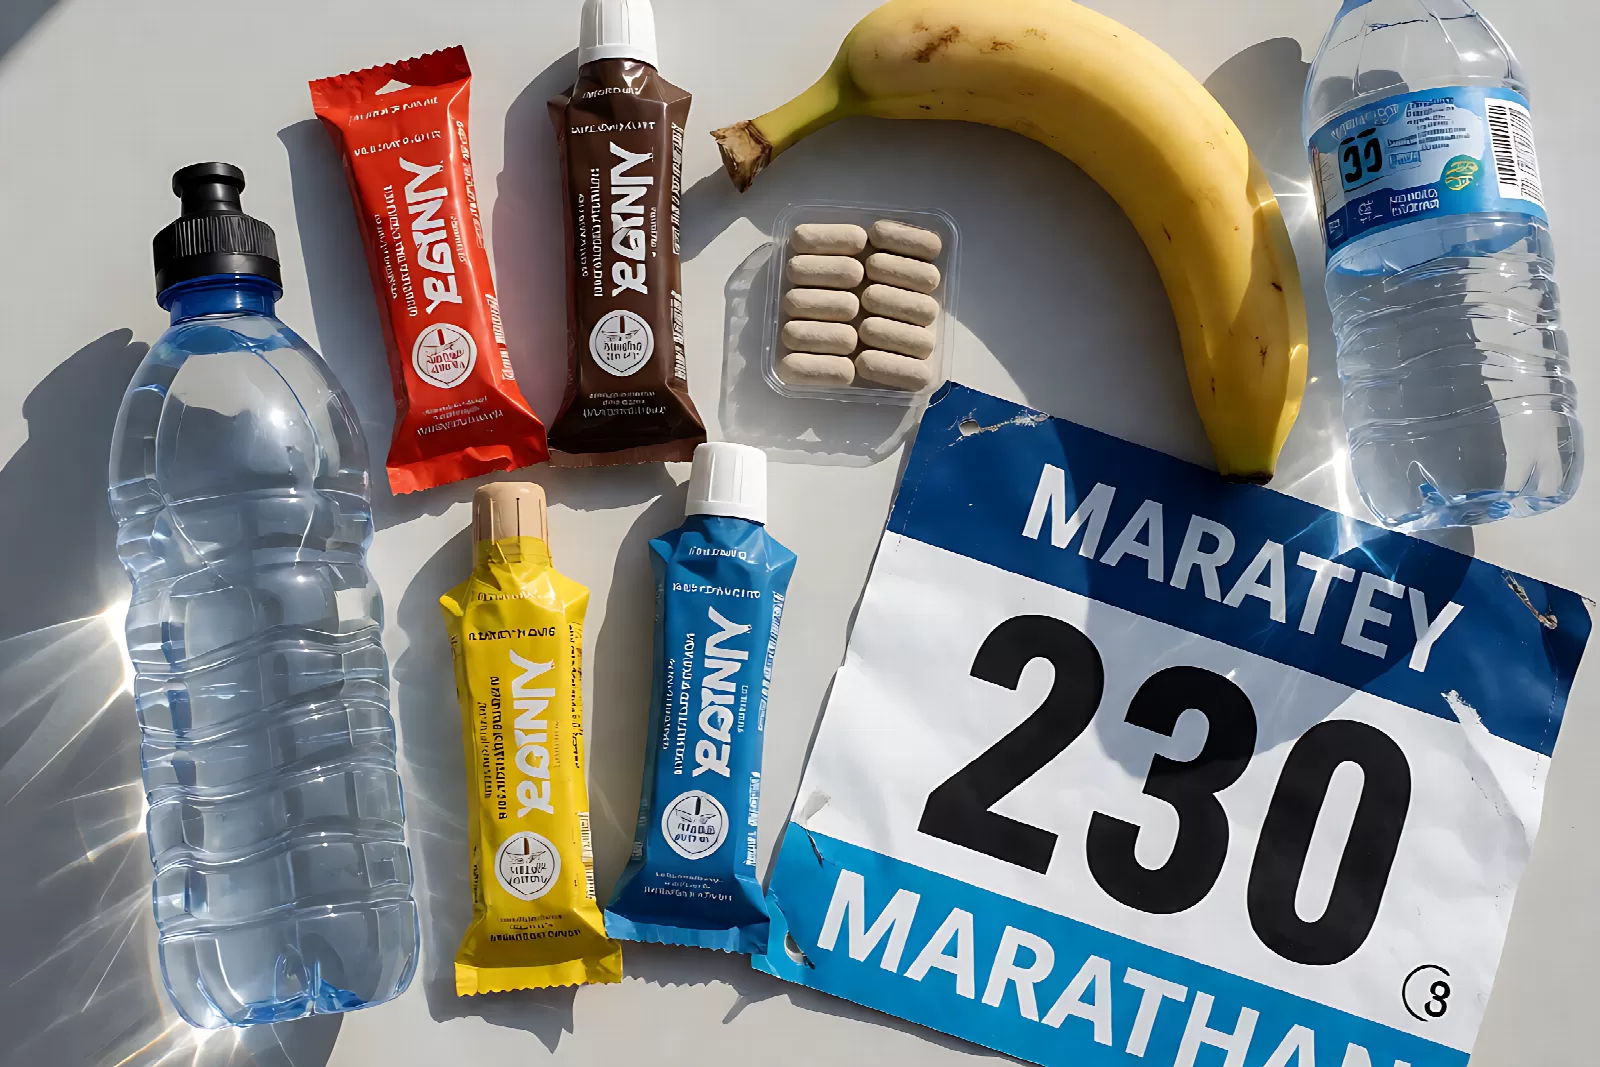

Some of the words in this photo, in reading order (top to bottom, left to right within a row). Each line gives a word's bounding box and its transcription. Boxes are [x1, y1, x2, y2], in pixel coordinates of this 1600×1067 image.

[1022, 463, 1464, 673] MARATEY
[917, 614, 1412, 966] 230
[816, 868, 1412, 1067] MARATH
